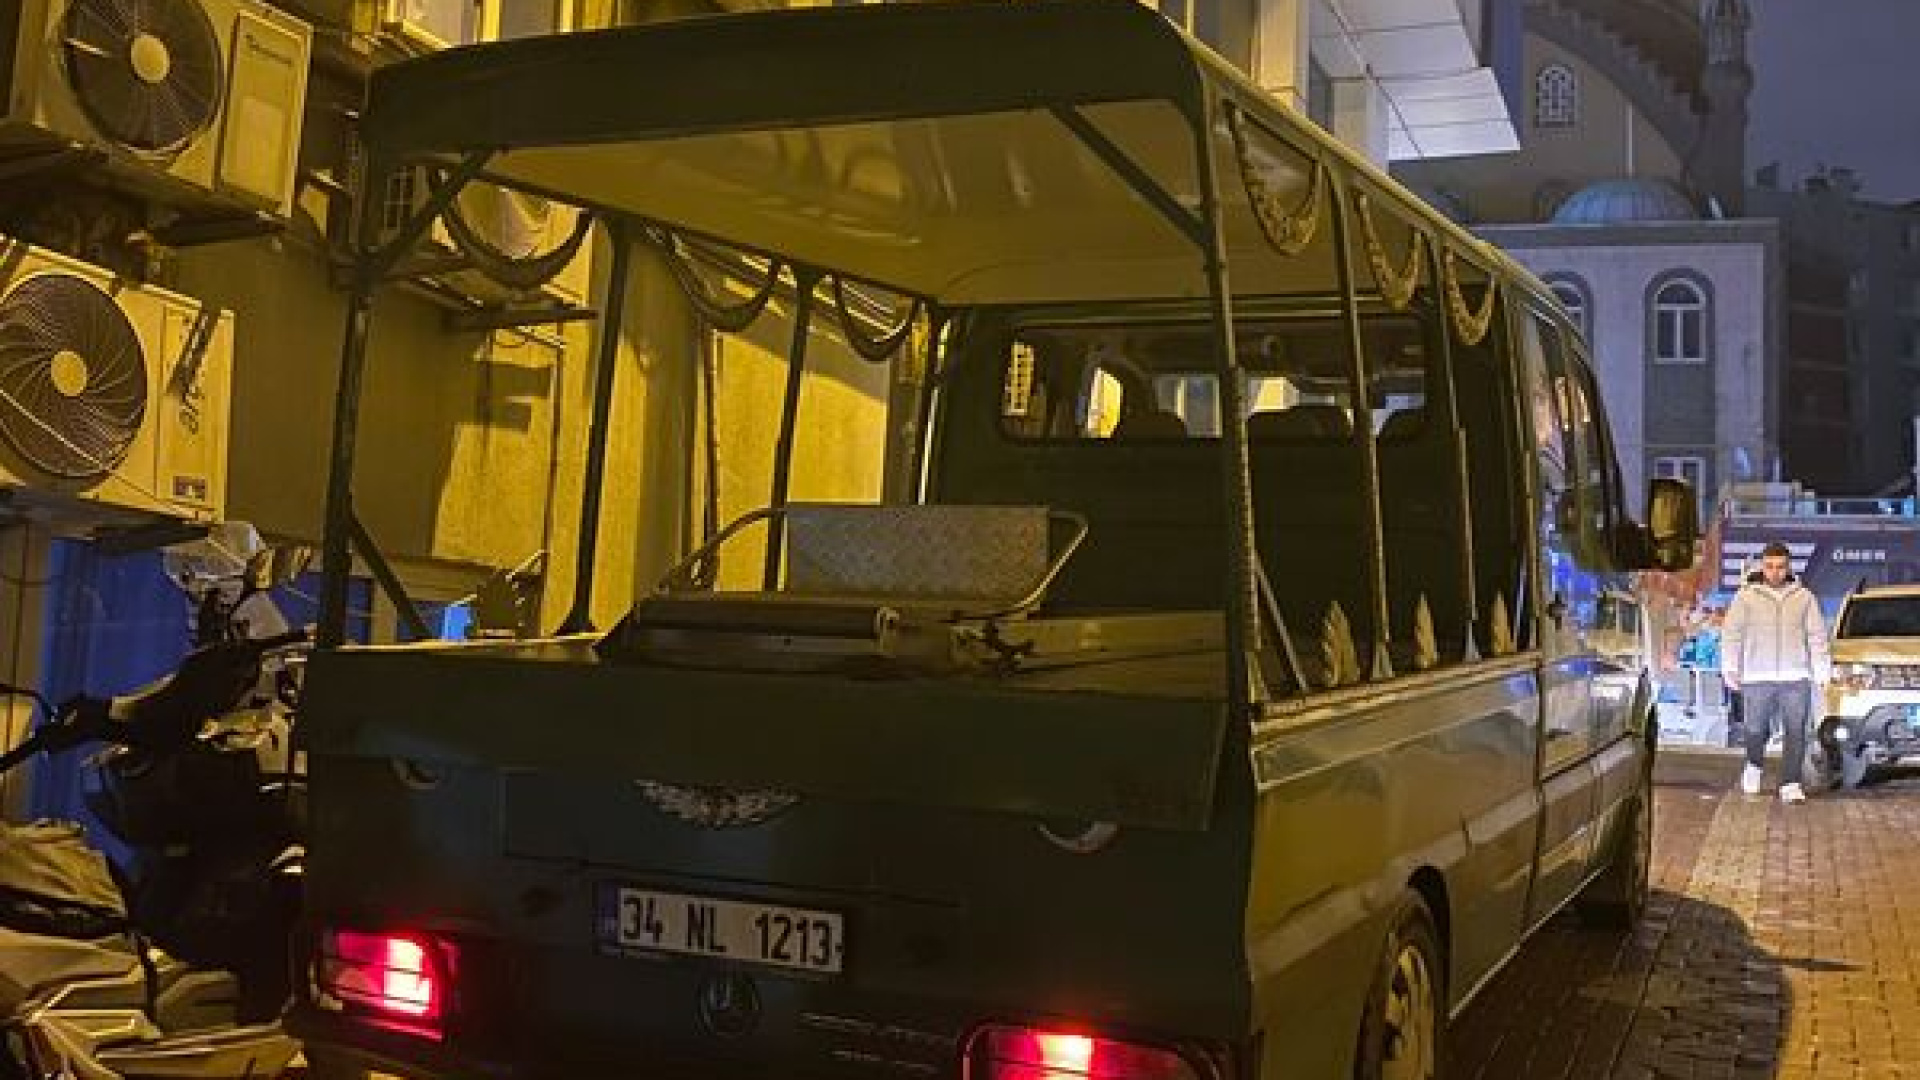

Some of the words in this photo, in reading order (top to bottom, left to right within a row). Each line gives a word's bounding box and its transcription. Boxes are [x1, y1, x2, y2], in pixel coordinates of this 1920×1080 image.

[623, 897, 662, 943] 34
[687, 903, 727, 953] NL
[755, 913, 831, 966] 1213
